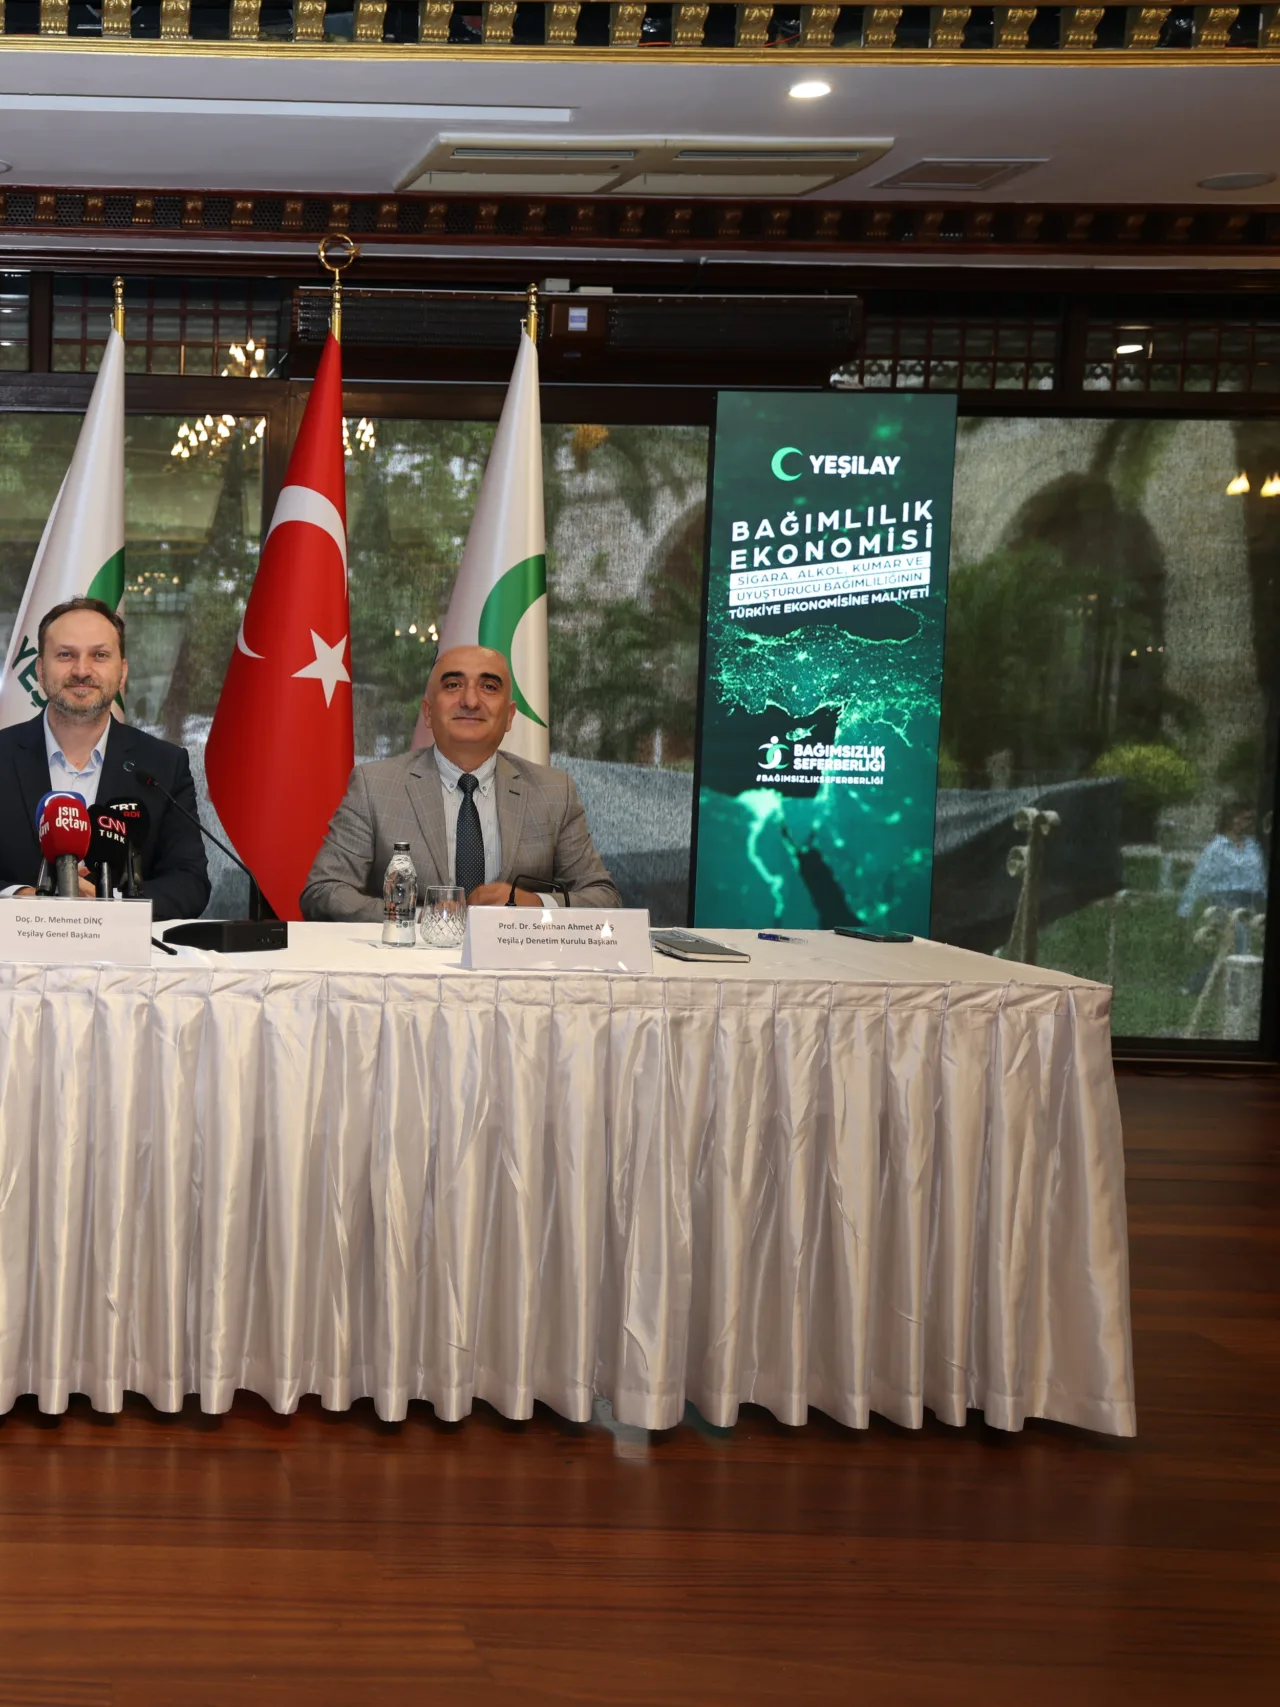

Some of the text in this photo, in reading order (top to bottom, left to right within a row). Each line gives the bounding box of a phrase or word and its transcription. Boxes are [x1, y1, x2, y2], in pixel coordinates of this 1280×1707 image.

[809, 455, 901, 478] YEŞİLAY
[732, 499, 933, 542] BAĞIMLILIK
[730, 523, 933, 570] EKONOMİSİ
[737, 556, 923, 586] SİGARA, ALKOL, KUMAR VE
[737, 572, 923, 601] UYUŞTURUCU BAĞIMLILIĞININ
[729, 585, 929, 620] TÜRKİYE EKONOMİSİNE MALİYETİ
[793, 742, 885, 758] BAĞIMSIZLIK
[793, 755, 885, 772] SEFERBERLİĞİ
[756, 774, 884, 785] #BAĞIMSIZLIKSEFERBERLİĞİ
[110, 803, 138, 811] TRT
[98, 815, 127, 836] CNN
[15, 915, 33, 924] Doç.
[48, 916, 82, 924] Mehmet
[83, 915, 103, 926] DİNÇ
[498, 922, 517, 930] Prof.
[532, 922, 566, 932] Seyithan
[567, 923, 594, 931] Ahmet
[17, 930, 101, 940] Yeşilay Genel Başkanı
[497, 937, 524, 946] Yeşilay
[526, 937, 559, 945] Denetim
[588, 938, 618, 947] Başkanı
